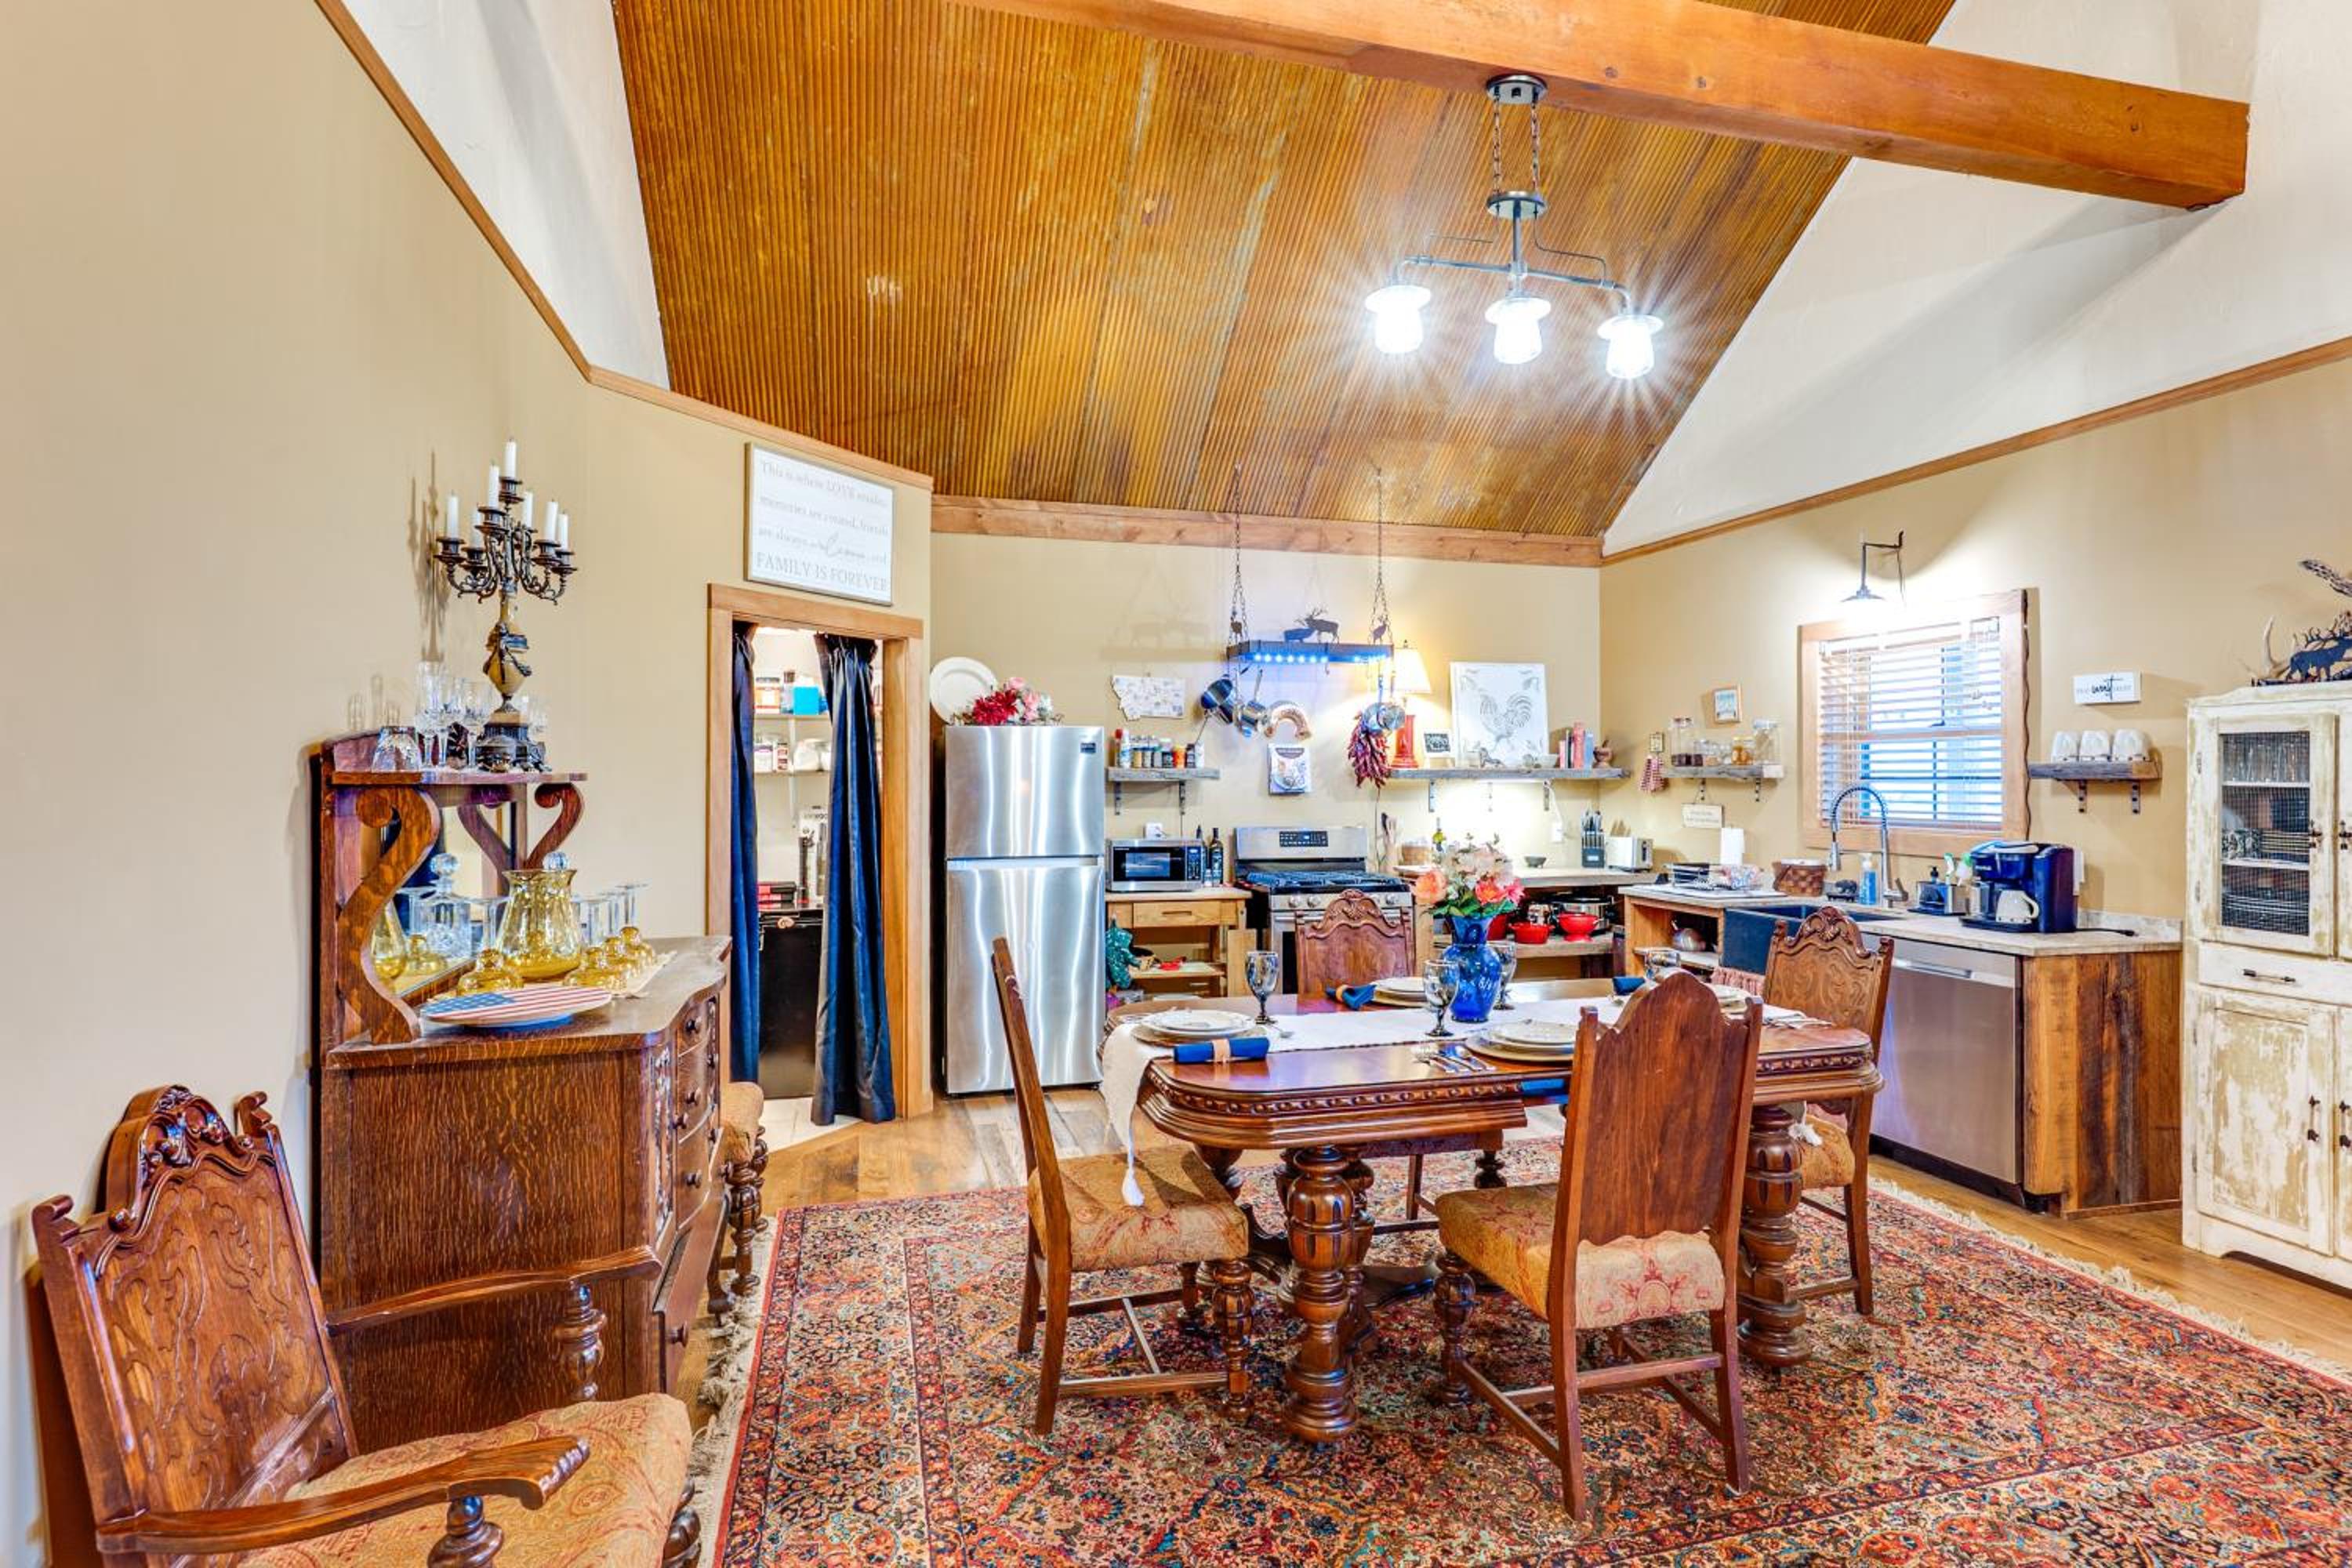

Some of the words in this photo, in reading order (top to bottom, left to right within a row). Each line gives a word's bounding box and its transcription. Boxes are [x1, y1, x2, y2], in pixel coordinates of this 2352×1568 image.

[757, 552, 812, 578] FAMILY
[815, 564, 829, 581] IS
[830, 567, 888, 591] FOREVER
